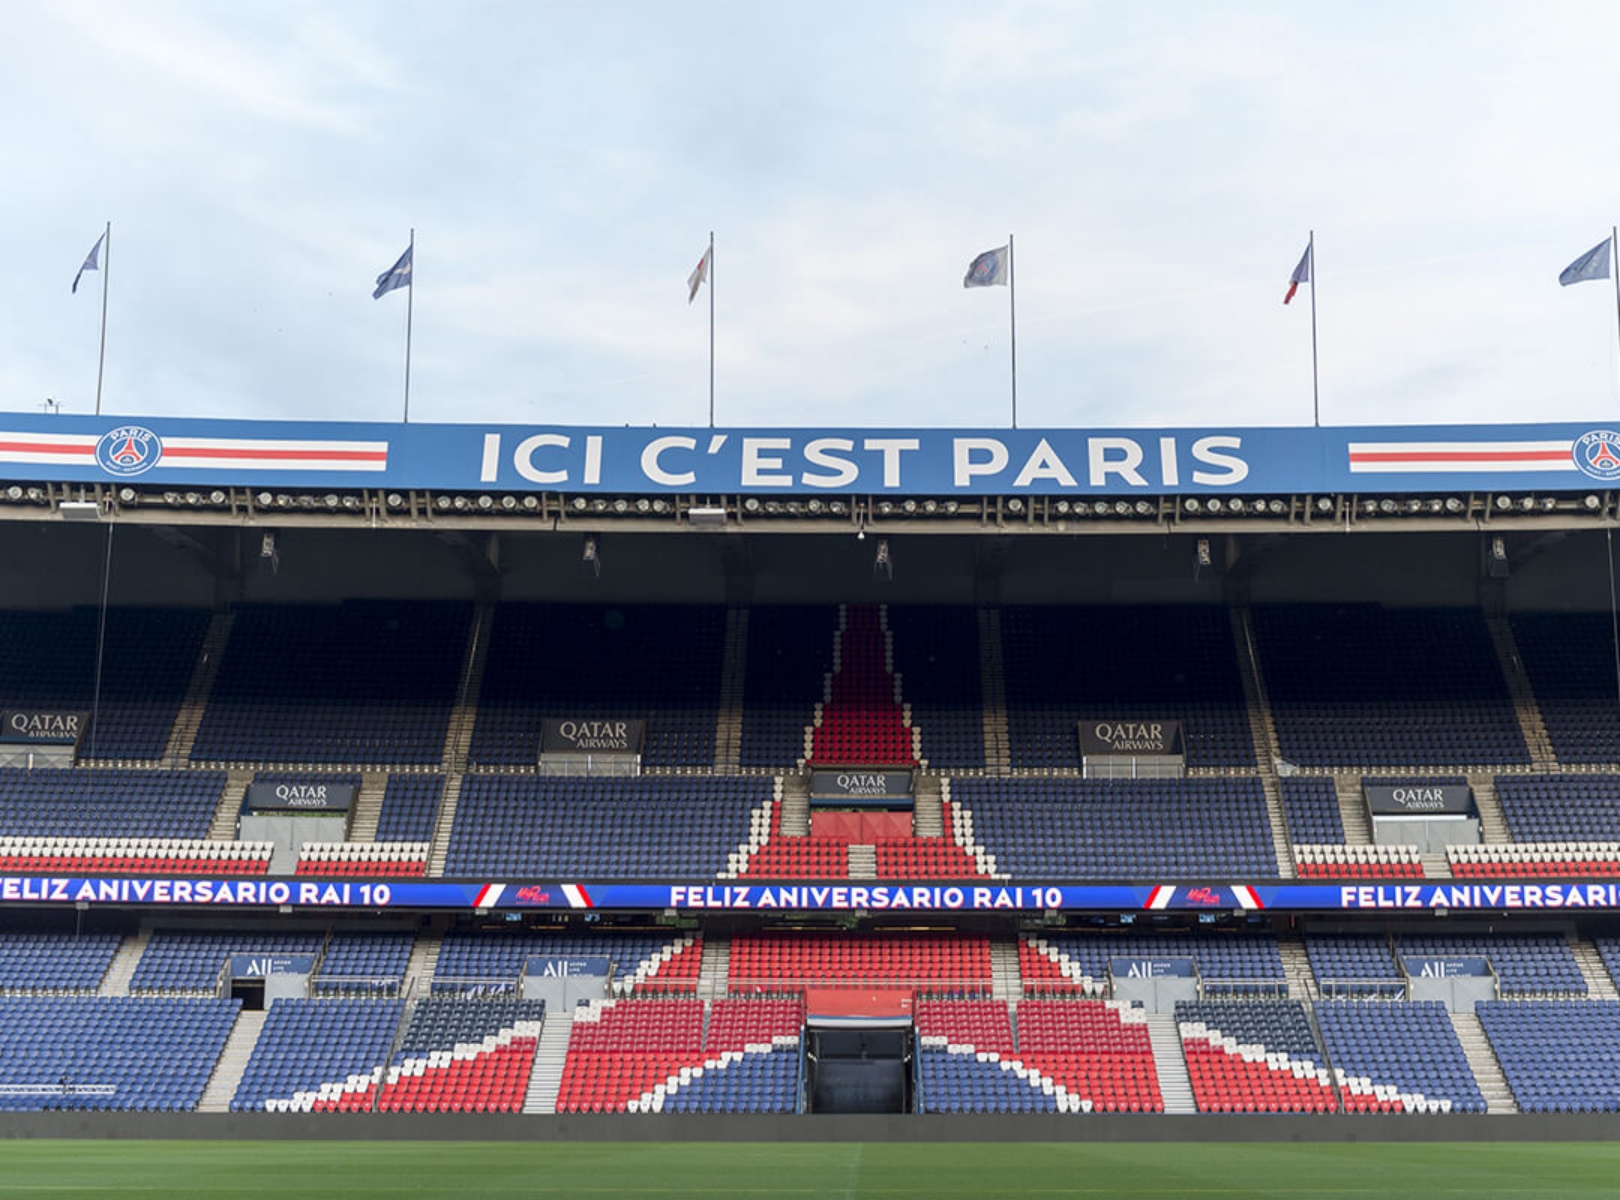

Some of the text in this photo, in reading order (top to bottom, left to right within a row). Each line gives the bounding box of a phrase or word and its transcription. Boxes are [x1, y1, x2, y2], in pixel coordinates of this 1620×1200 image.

[110, 428, 153, 442] PARIS
[480, 433, 603, 484] ICI
[953, 435, 1249, 486] PARIS
[11, 713, 79, 733] QATAR
[560, 721, 627, 741] QATAR
[1095, 723, 1162, 743] QATAR
[576, 738, 628, 749] AIRWAYS
[1112, 740, 1164, 751] AIRWAYS
[836, 774, 886, 790] QATAR
[848, 786, 887, 795] AIRWAYS
[275, 784, 327, 801] QATAR
[1392, 788, 1444, 805] QATAR
[287, 798, 327, 807] AIRWAYS
[1404, 801, 1444, 810] AIRWAYS
[0, 877, 69, 900] ELIZ
[300, 882, 350, 904] RAI
[359, 884, 391, 905] 10
[670, 886, 751, 908] FELIZ
[973, 887, 1023, 908] RAI
[1031, 887, 1062, 908] 10
[1341, 885, 1620, 908] FELIZ ANIVERSARI
